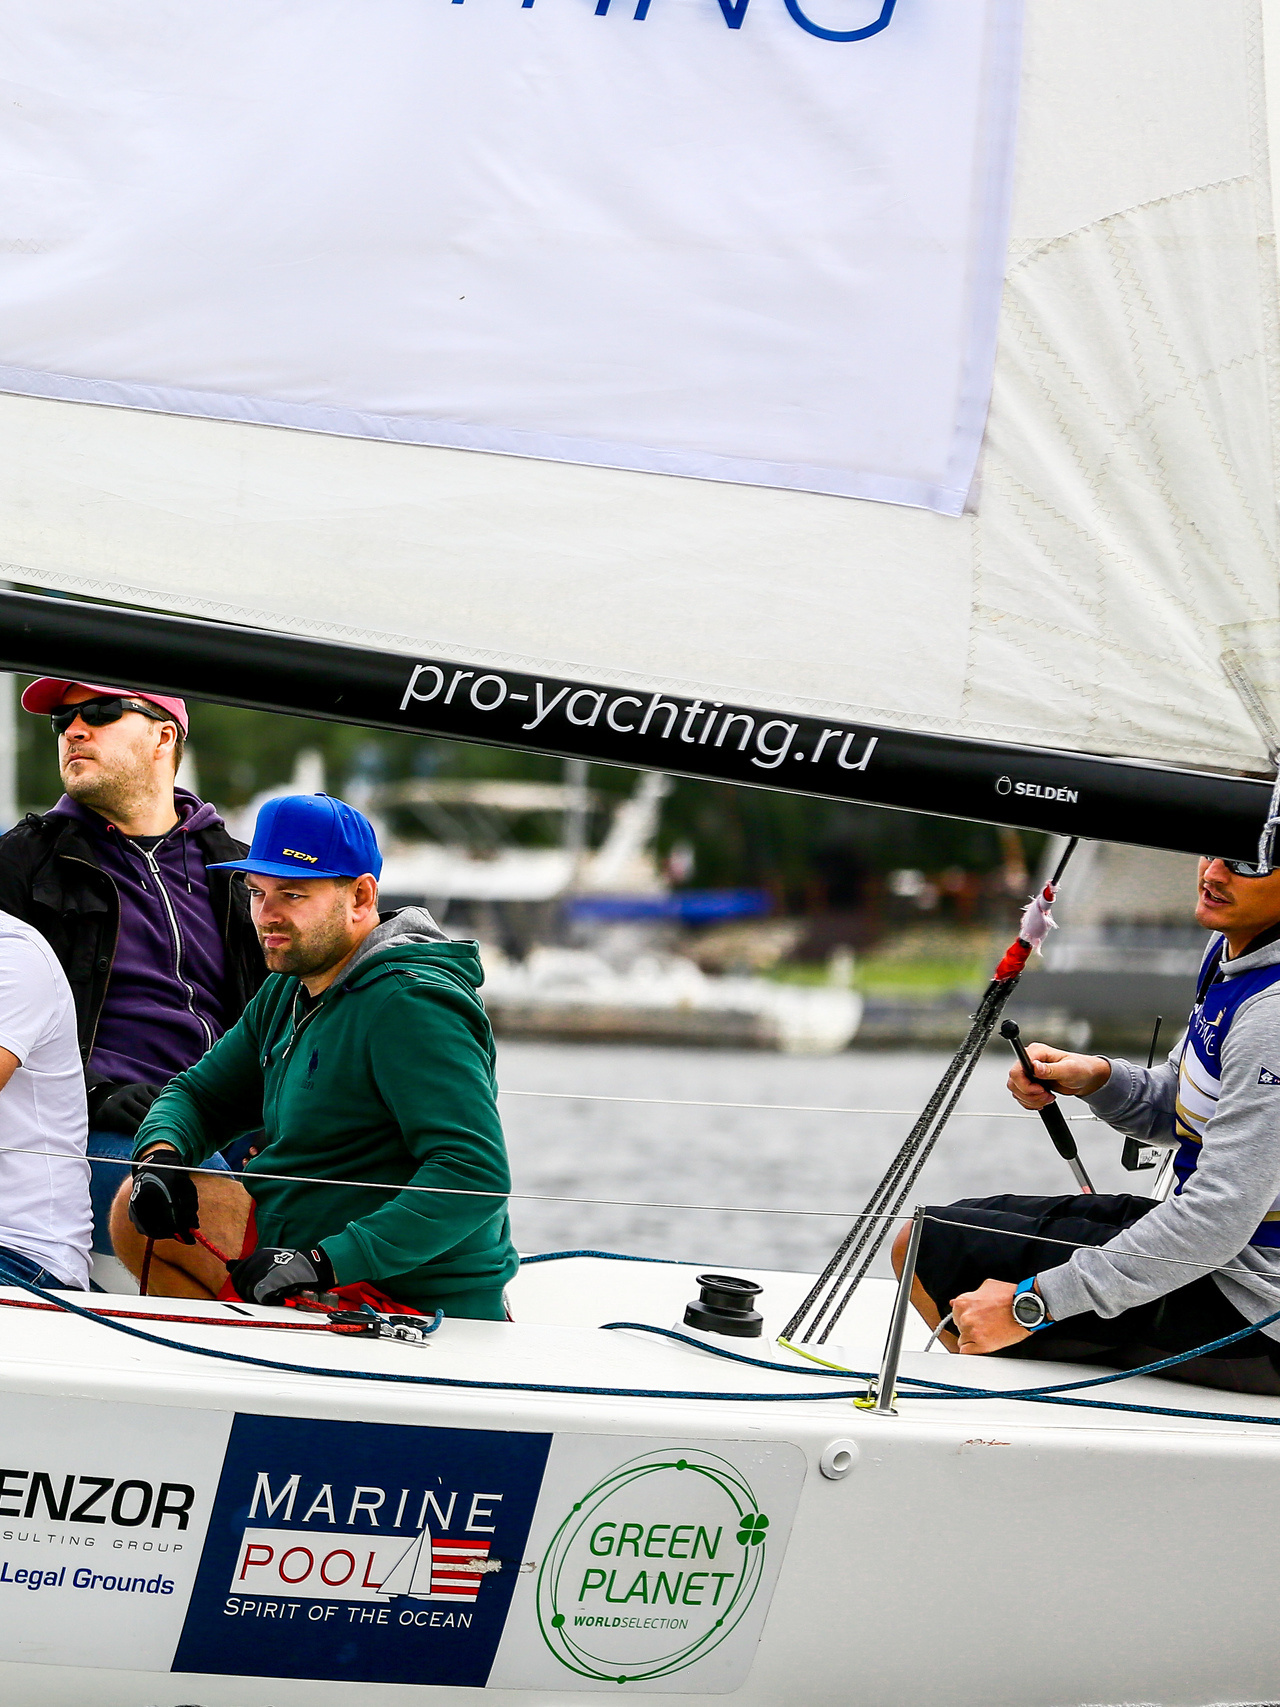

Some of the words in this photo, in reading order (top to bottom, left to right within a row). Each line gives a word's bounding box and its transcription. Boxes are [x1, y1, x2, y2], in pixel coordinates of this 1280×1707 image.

[399, 663, 879, 771] pro-yachting.ru
[1013, 782, 1079, 804] SELDÉN
[282, 848, 319, 864] CCM
[247, 1472, 503, 1533] MARINE
[112, 1540, 184, 1553] GROUP
[589, 1522, 723, 1559] GREEN
[0, 1562, 66, 1590] Legal
[72, 1568, 175, 1595] Grounds
[239, 1543, 384, 1588] POOL
[578, 1568, 735, 1606] PLANET
[223, 1598, 301, 1620] SPIRIT
[308, 1605, 340, 1622] OF
[347, 1607, 391, 1625] THE
[399, 1611, 473, 1629] OCEAN
[574, 1616, 689, 1630] WORLDSELECTION
